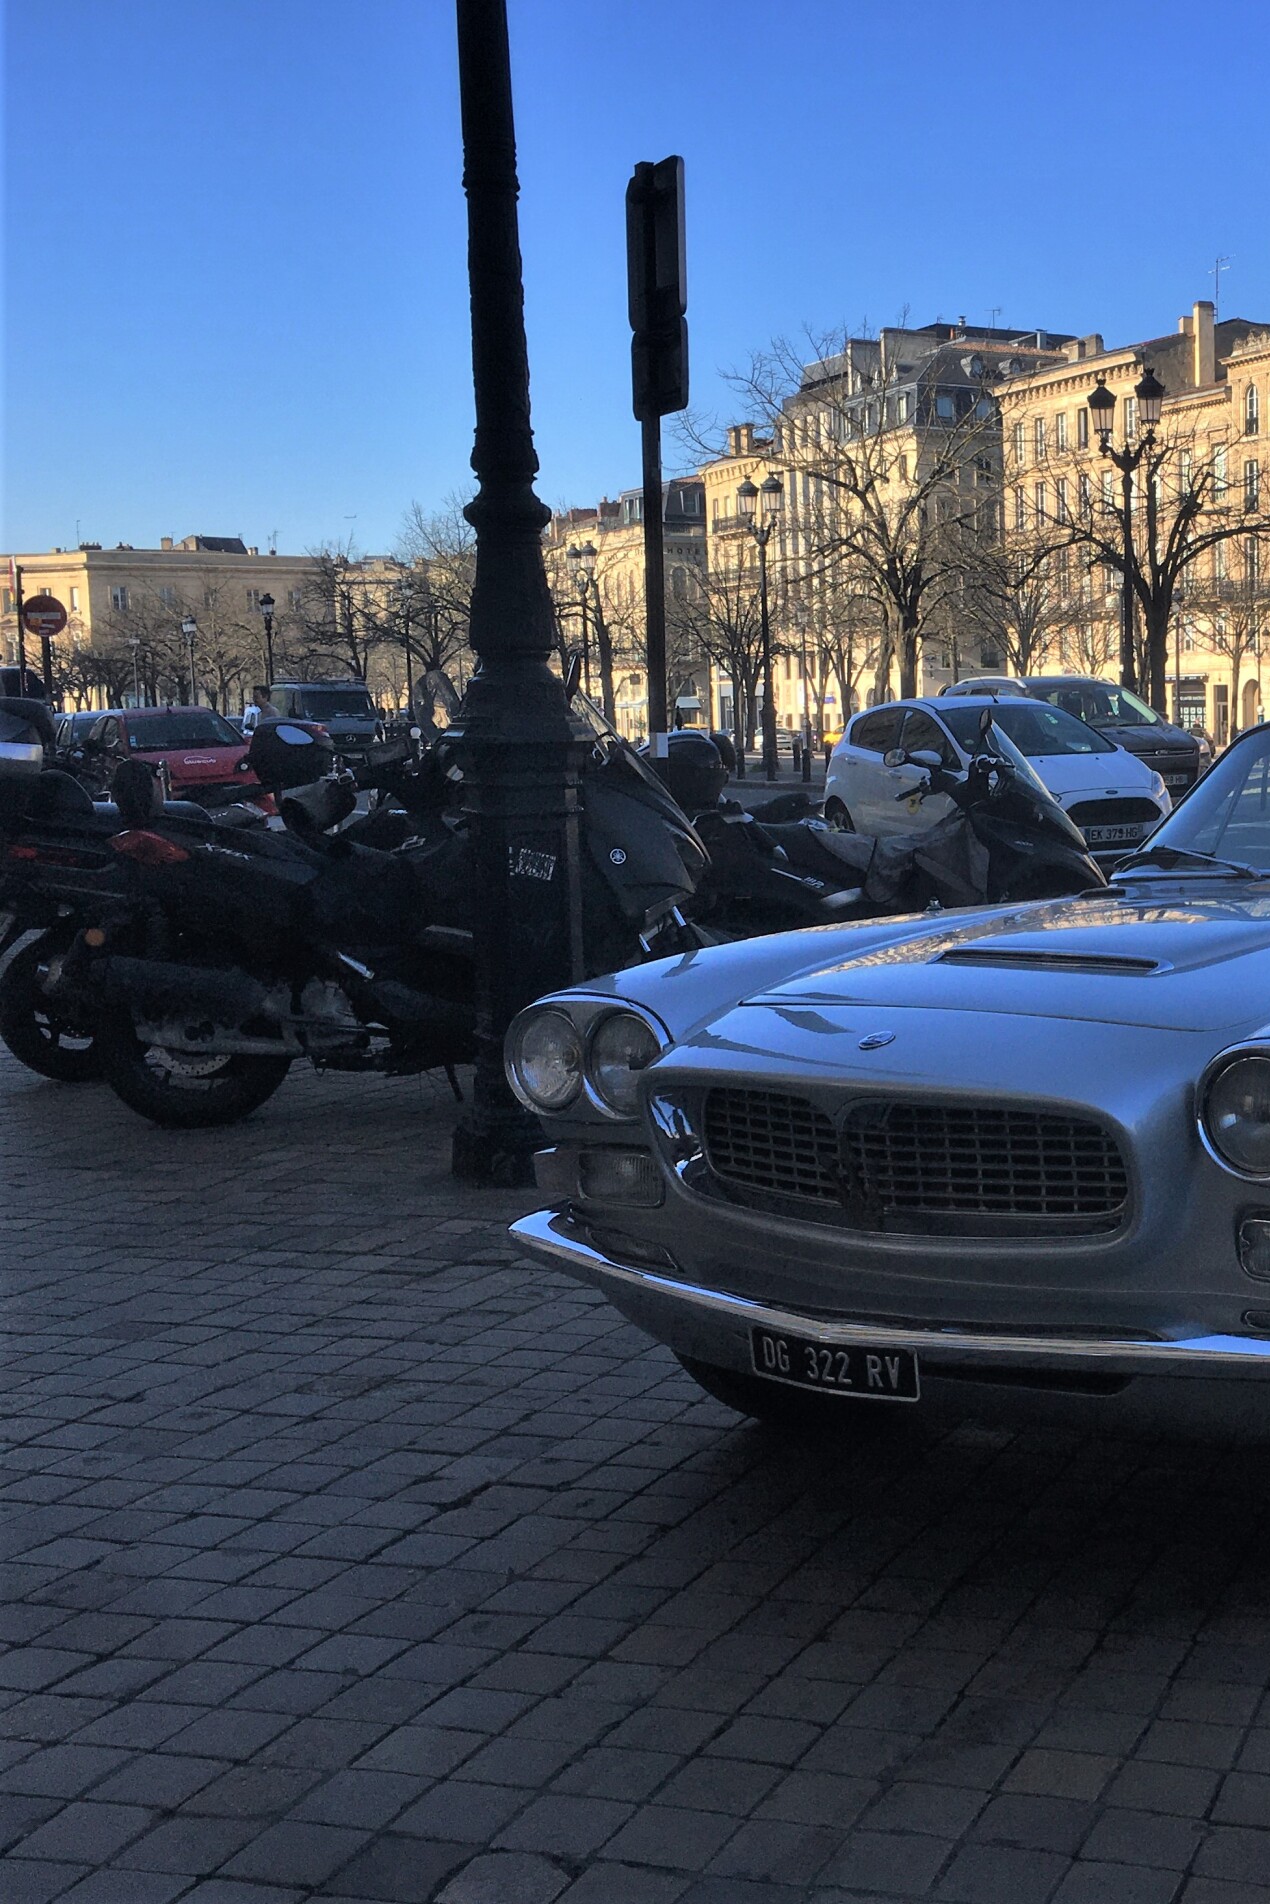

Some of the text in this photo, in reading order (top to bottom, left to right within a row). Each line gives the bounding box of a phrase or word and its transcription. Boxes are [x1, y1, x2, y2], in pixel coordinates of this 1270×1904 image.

[1091, 829, 1104, 840] EK
[762, 1336, 900, 1389] DG 322 RV
